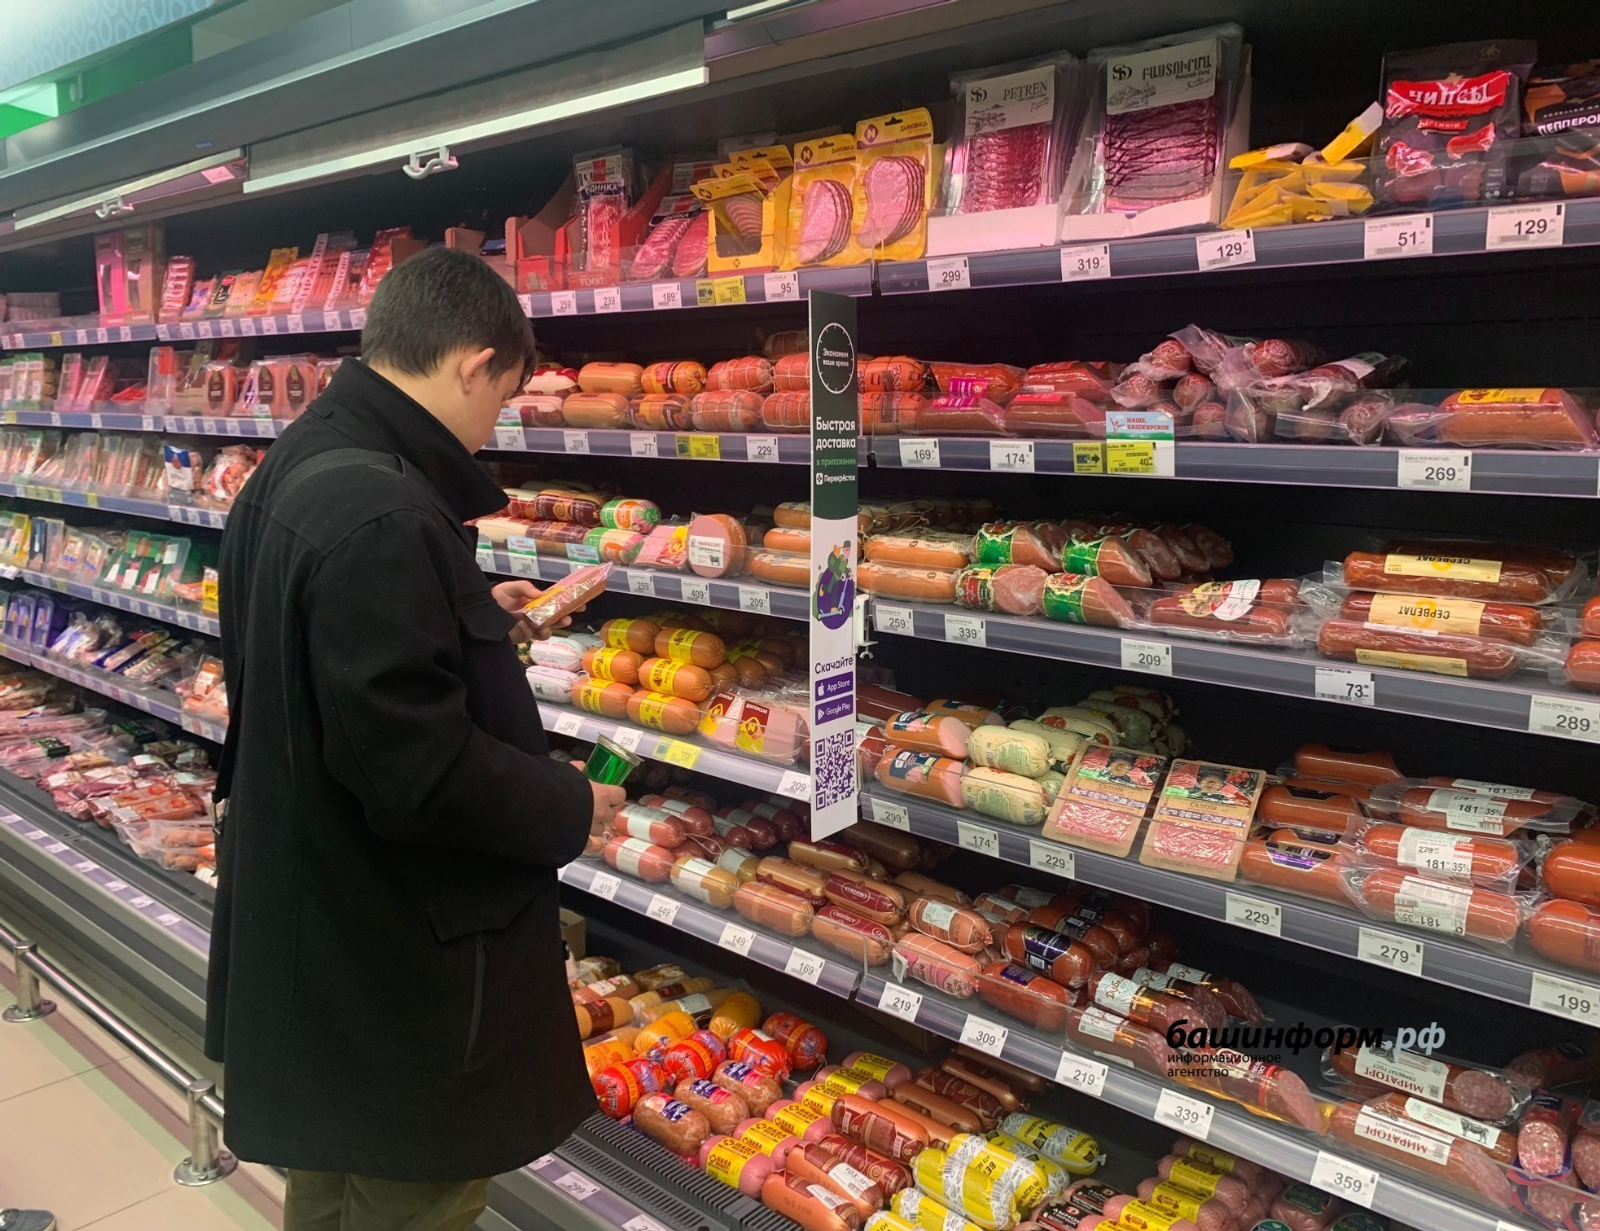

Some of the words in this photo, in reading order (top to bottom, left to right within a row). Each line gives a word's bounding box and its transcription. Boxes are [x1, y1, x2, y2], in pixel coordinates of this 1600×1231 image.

[1003, 81, 1048, 101] PETREN
[1514, 218, 1547, 235] 129
[1398, 231, 1417, 247] 51
[1216, 242, 1243, 259] 129
[1077, 257, 1100, 271] 319
[942, 270, 961, 283] 299
[780, 284, 792, 293] 95
[816, 416, 856, 434] Быстрая
[644, 443, 652, 452] 77
[816, 437, 856, 450] доставка
[757, 446, 772, 456] 229
[913, 449, 931, 461] 169
[821, 458, 856, 471] приложении
[1005, 452, 1025, 465] 174
[824, 474, 856, 484] Перекрёсток
[1425, 467, 1456, 481] 269
[691, 590, 705, 600] 409
[750, 597, 764, 608] 209
[1398, 604, 1451, 620] СЕРВЕЛАТ
[889, 617, 906, 629] 259
[958, 627, 977, 638] 339
[814, 656, 854, 674] Скачайте
[1138, 653, 1161, 667] 209
[827, 681, 837, 693] App
[838, 678, 851, 691] Store
[1345, 683, 1363, 698] 73
[826, 706, 841, 717] Google
[841, 704, 851, 714] Play
[1556, 714, 1591, 732] 289
[790, 781, 807, 792] 209
[884, 811, 902, 823] 299
[1458, 804, 1479, 814] 181
[1484, 807, 1503, 817] 35%
[972, 835, 991, 848] 174
[1045, 854, 1065, 868] 229
[1425, 859, 1445, 870] 181
[1452, 862, 1470, 874] 35%
[599, 883, 612, 894] 419
[657, 905, 671, 917] 449
[1244, 908, 1270, 925] 229
[1420, 916, 1441, 928] 181
[731, 934, 746, 947] 149
[1380, 944, 1409, 965] 279
[799, 962, 815, 975] 169
[893, 997, 911, 1012] 219
[1557, 993, 1591, 1014] 199
[975, 1031, 996, 1046] 309
[1072, 1069, 1095, 1087] 219
[1363, 1067, 1424, 1094] МИРАТОРГ
[1174, 1105, 1199, 1124] 339
[1363, 1125, 1428, 1154] МИРАТОРГ
[1333, 1172, 1363, 1194] 359
